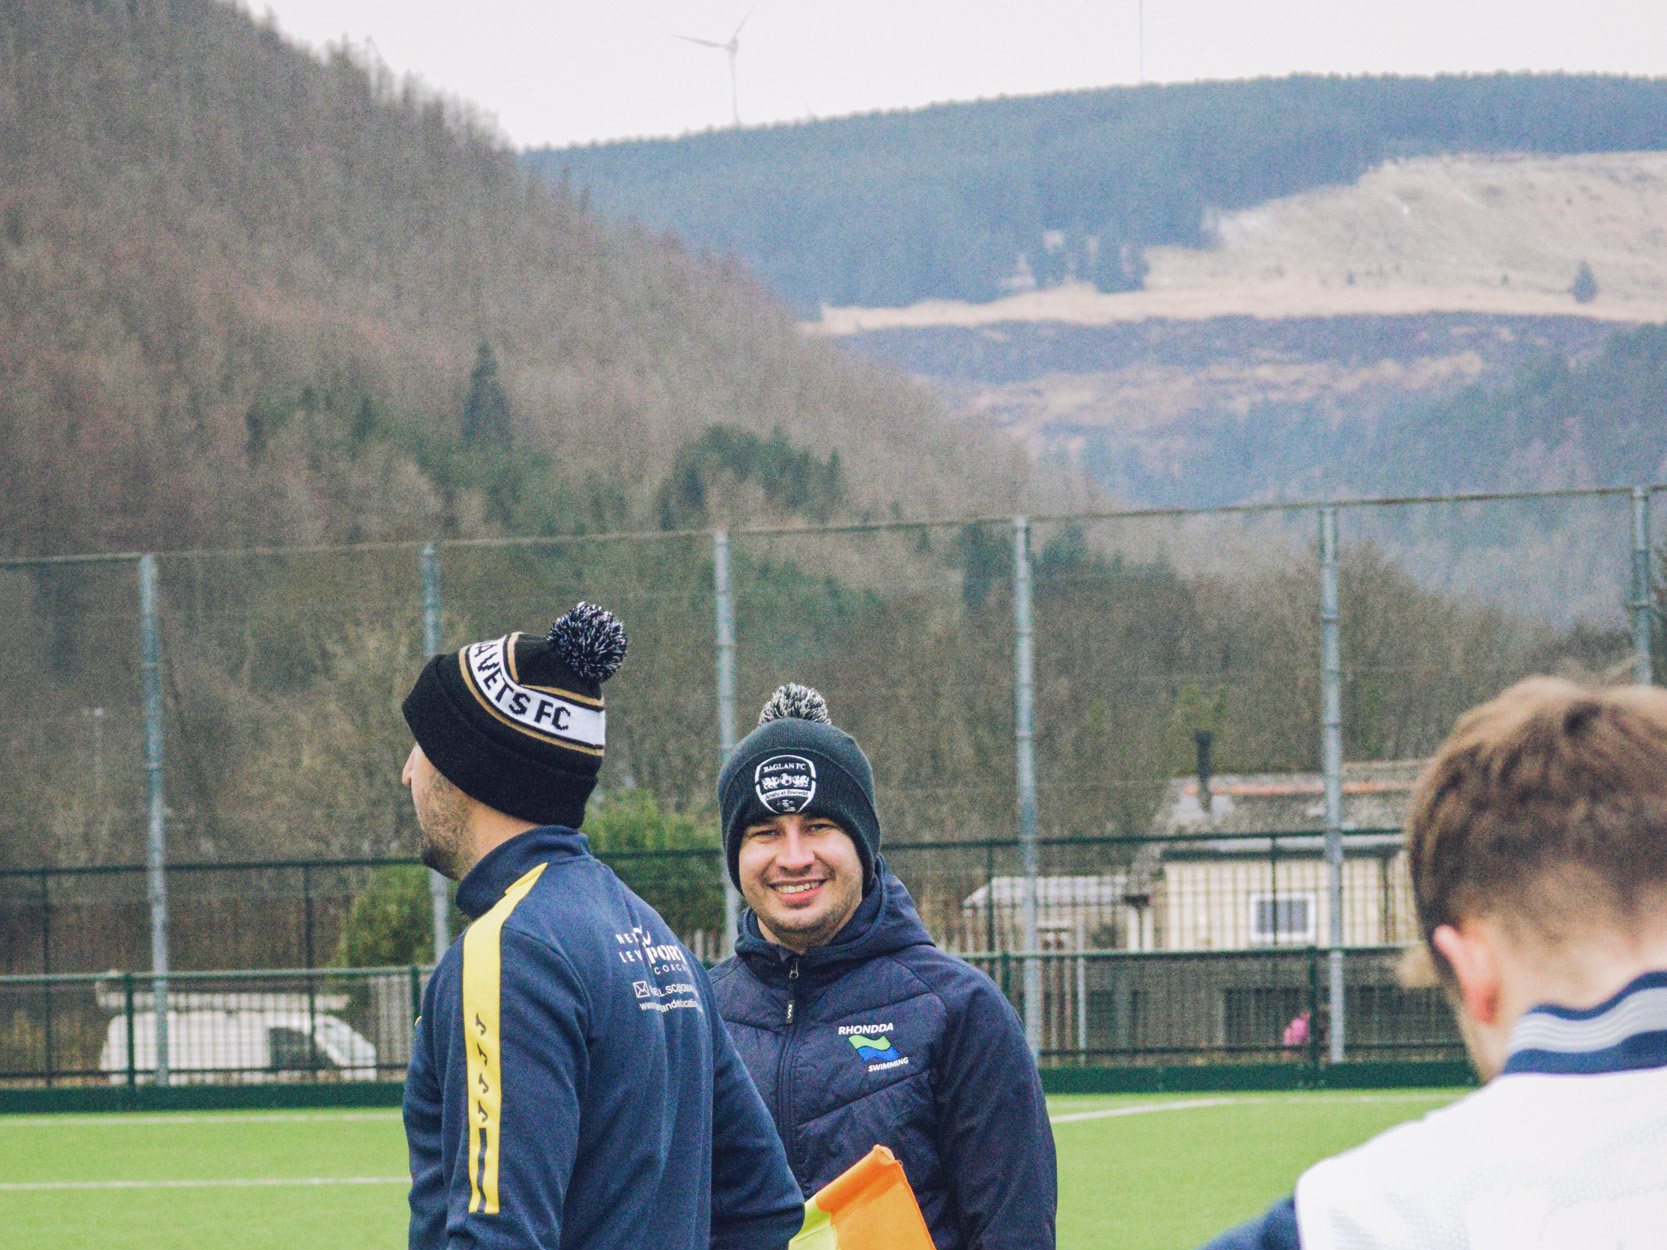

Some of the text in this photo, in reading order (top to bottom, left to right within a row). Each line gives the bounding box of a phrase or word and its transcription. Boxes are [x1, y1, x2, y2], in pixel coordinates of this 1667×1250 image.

[534, 700, 571, 731] FC
[763, 763, 794, 773] BAGLAN
[838, 1022, 894, 1035] RHONDDA
[868, 1056, 909, 1073] SWIMMING
